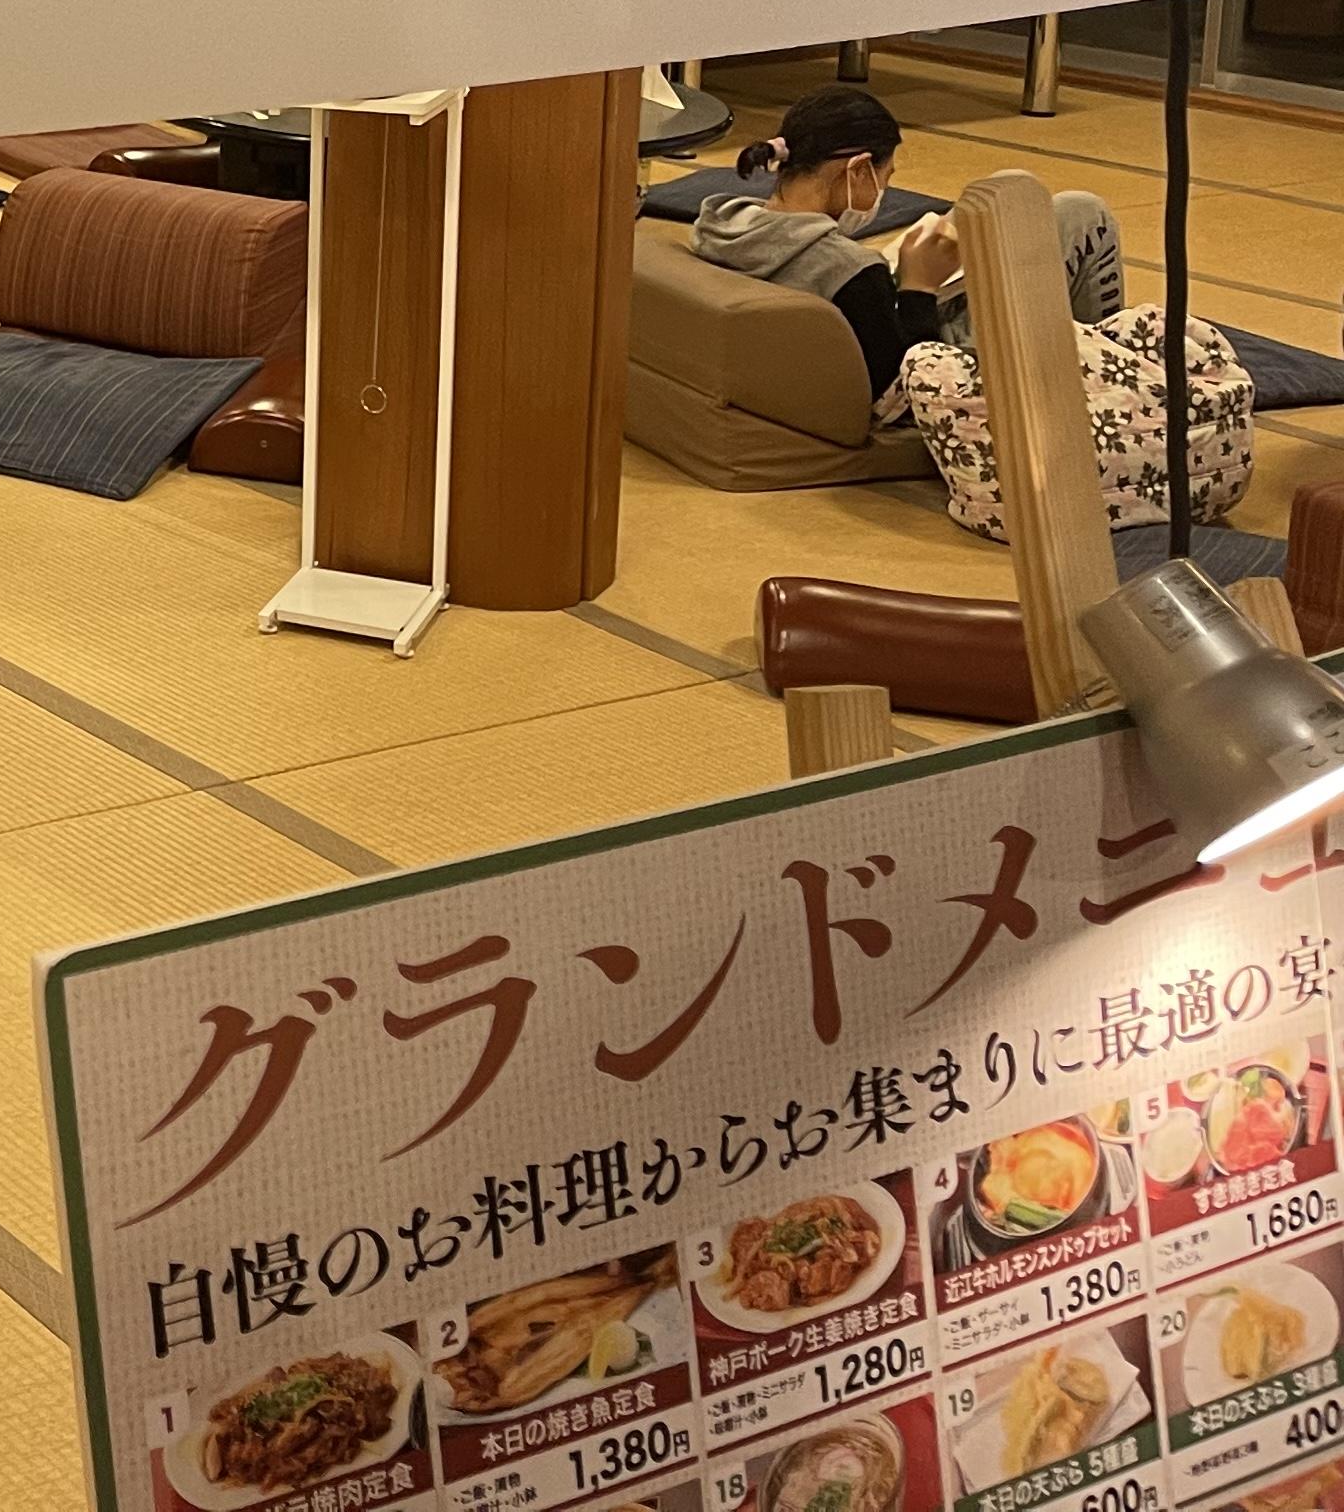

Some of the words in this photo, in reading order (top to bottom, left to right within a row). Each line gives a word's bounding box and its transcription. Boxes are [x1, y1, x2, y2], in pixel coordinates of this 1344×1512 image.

[1147, 1097, 1161, 1121] 5
[934, 1167, 950, 1190] 4
[1246, 1189, 1339, 1251] 1,680円
[697, 1241, 714, 1266] 3
[1040, 1260, 1141, 1325] 1,380円
[440, 1319, 459, 1348] 2
[1159, 1309, 1186, 1336] 20
[708, 1291, 919, 1386] 神戸ポーク生姜焼き定食
[813, 1337, 926, 1404] 1,280円
[948, 1388, 975, 1417] 19
[162, 1406, 174, 1434] 1
[480, 1380, 657, 1462] 本日の焼き魚定食
[568, 1420, 691, 1492] 1,380円
[715, 1473, 745, 1504] 18
